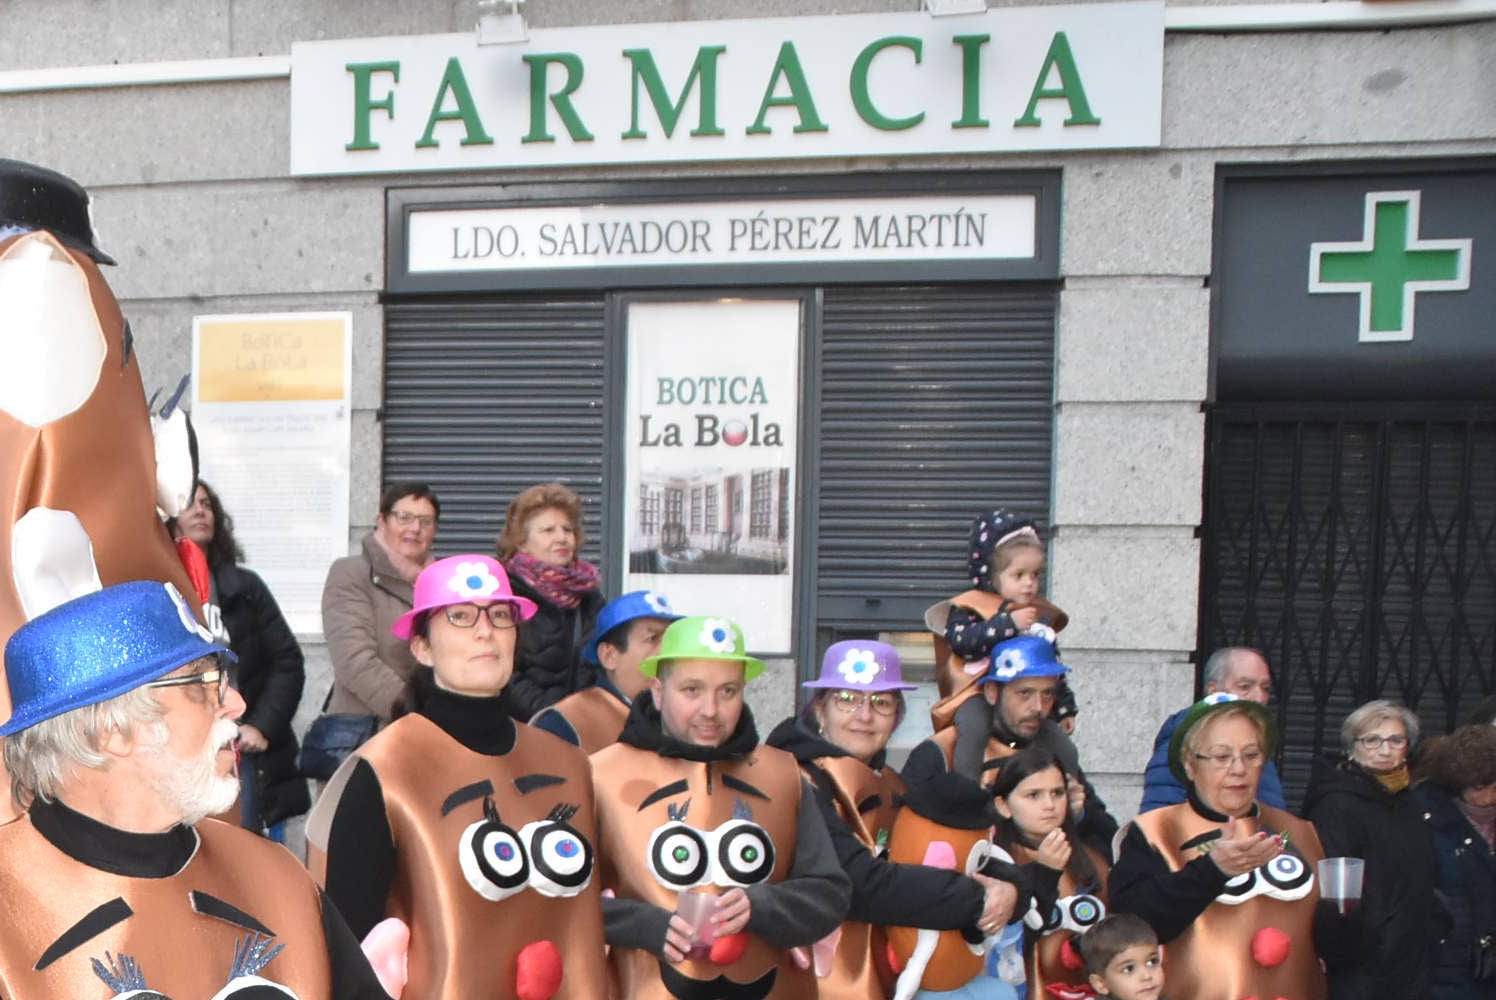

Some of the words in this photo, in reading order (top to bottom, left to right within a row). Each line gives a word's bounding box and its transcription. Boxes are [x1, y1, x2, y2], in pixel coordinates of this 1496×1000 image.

[345, 31, 1102, 151] FARMACIA
[452, 224, 526, 259] LDO.
[538, 219, 712, 256] SALVADOR
[728, 210, 841, 252] PÉREZ
[854, 207, 987, 249] MARTÍN
[656, 376, 769, 405] BOTICA
[639, 414, 684, 448] La
[694, 412, 784, 448] Bola
